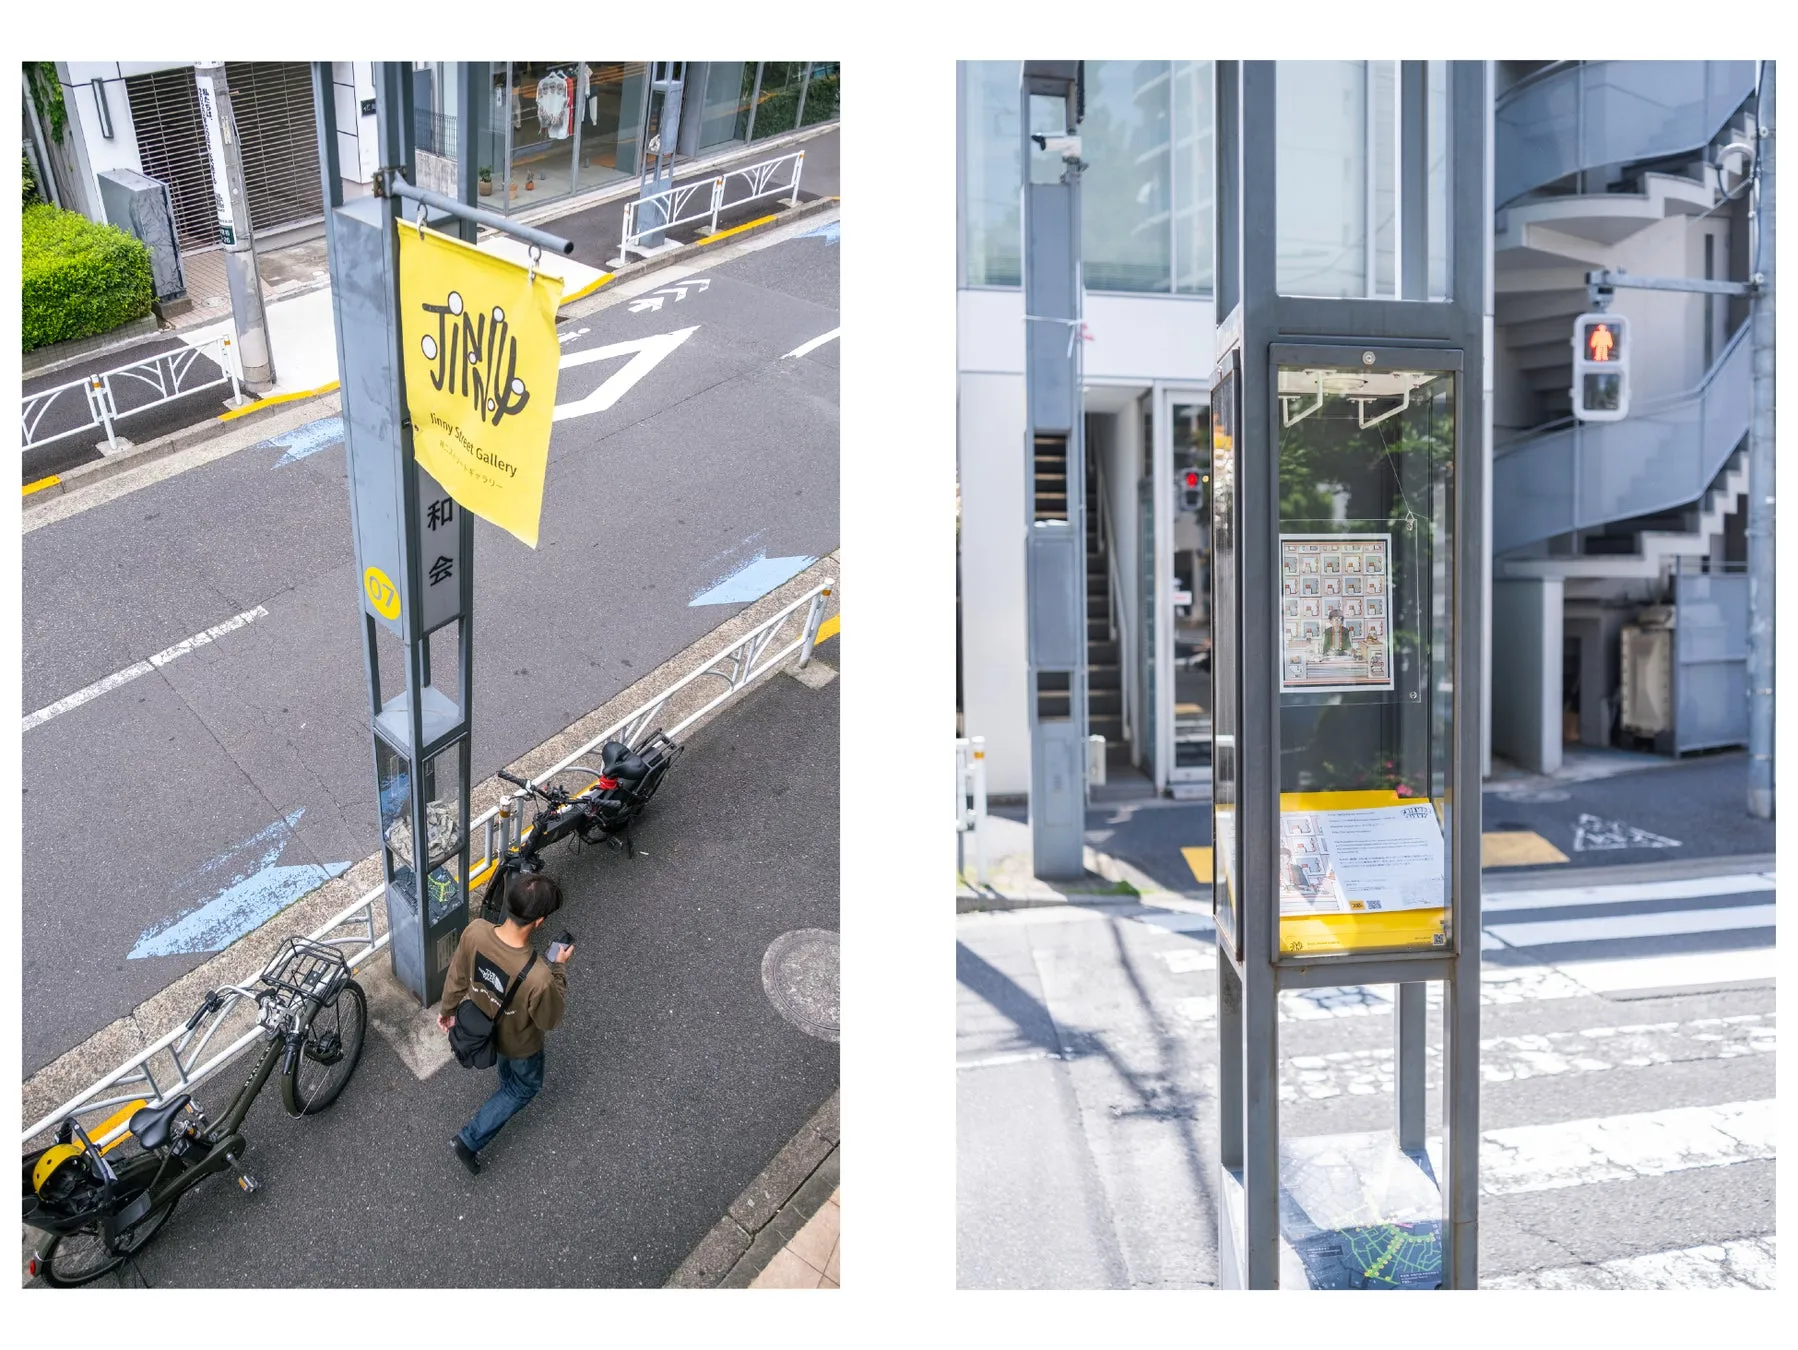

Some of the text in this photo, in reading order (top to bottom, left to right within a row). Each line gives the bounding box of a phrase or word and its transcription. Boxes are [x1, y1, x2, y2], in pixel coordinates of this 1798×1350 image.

[430, 412, 517, 477] Jinny Street Gallery
[369, 575, 395, 609] 07
